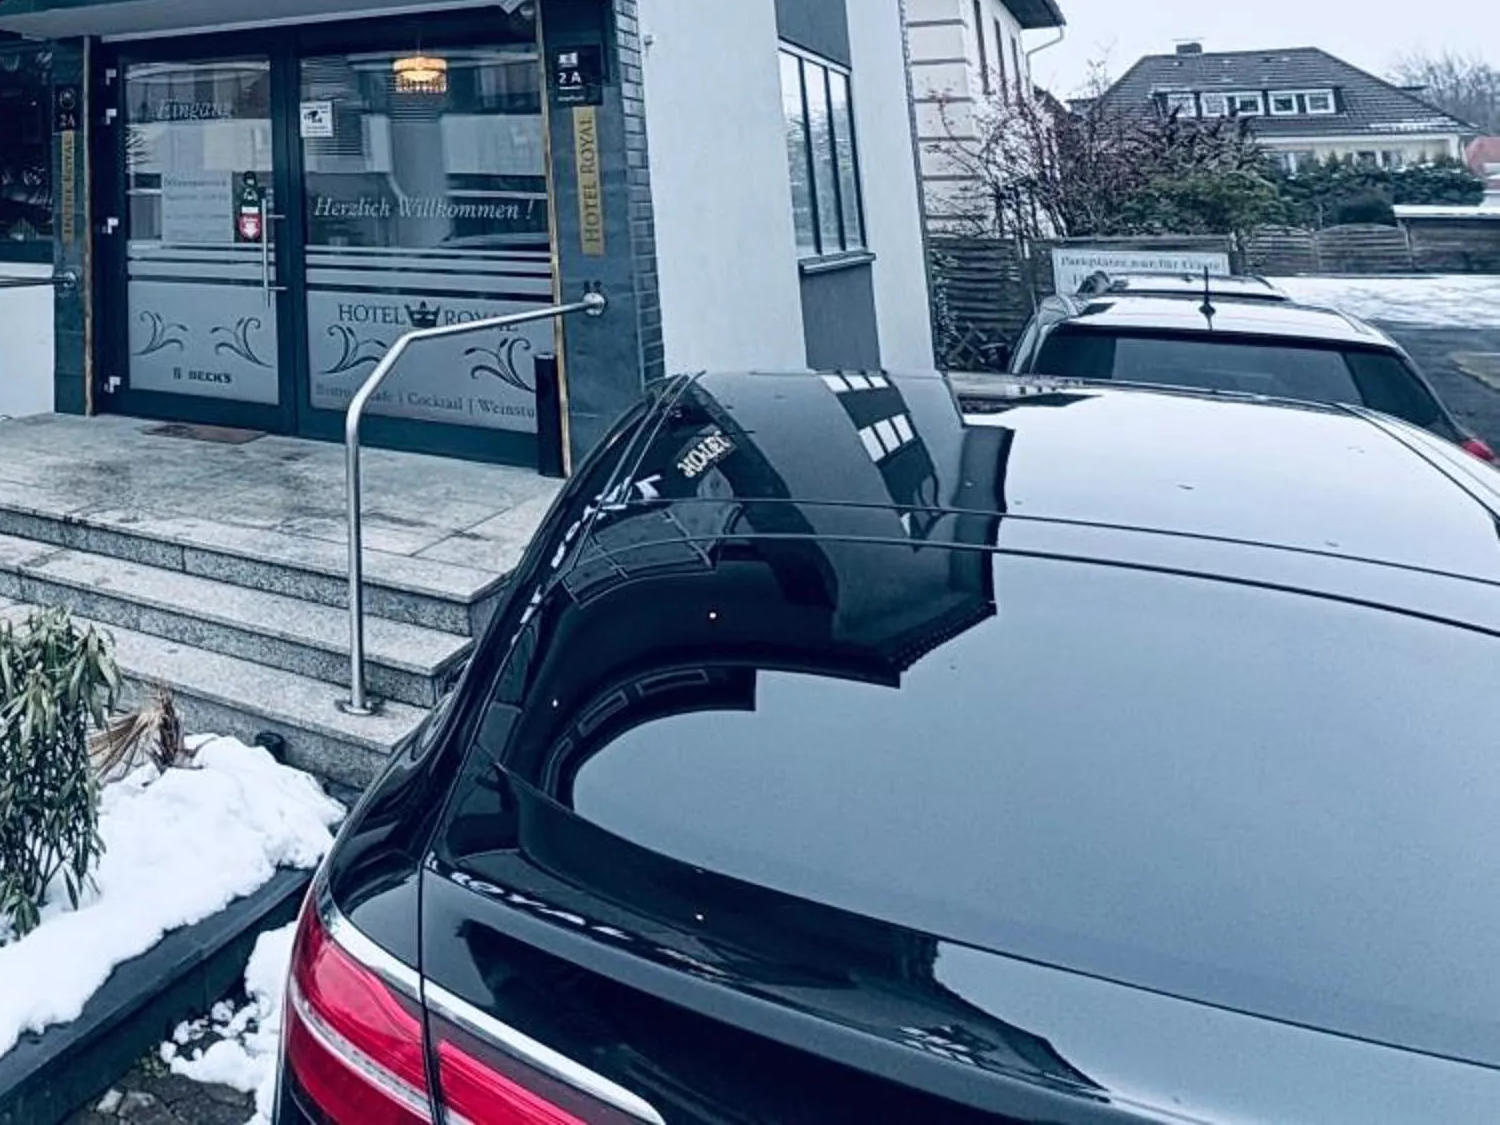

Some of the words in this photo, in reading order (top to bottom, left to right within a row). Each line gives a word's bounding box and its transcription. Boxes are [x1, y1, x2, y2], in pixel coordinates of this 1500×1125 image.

[579, 118, 596, 175] ROYAL
[313, 196, 391, 218] Herzlich
[399, 197, 519, 219] Willkommen
[583, 181, 600, 244] HOTEL
[338, 303, 407, 325] HOTEL
[407, 391, 463, 411] Cocktail
[477, 398, 536, 418] Weinstu
